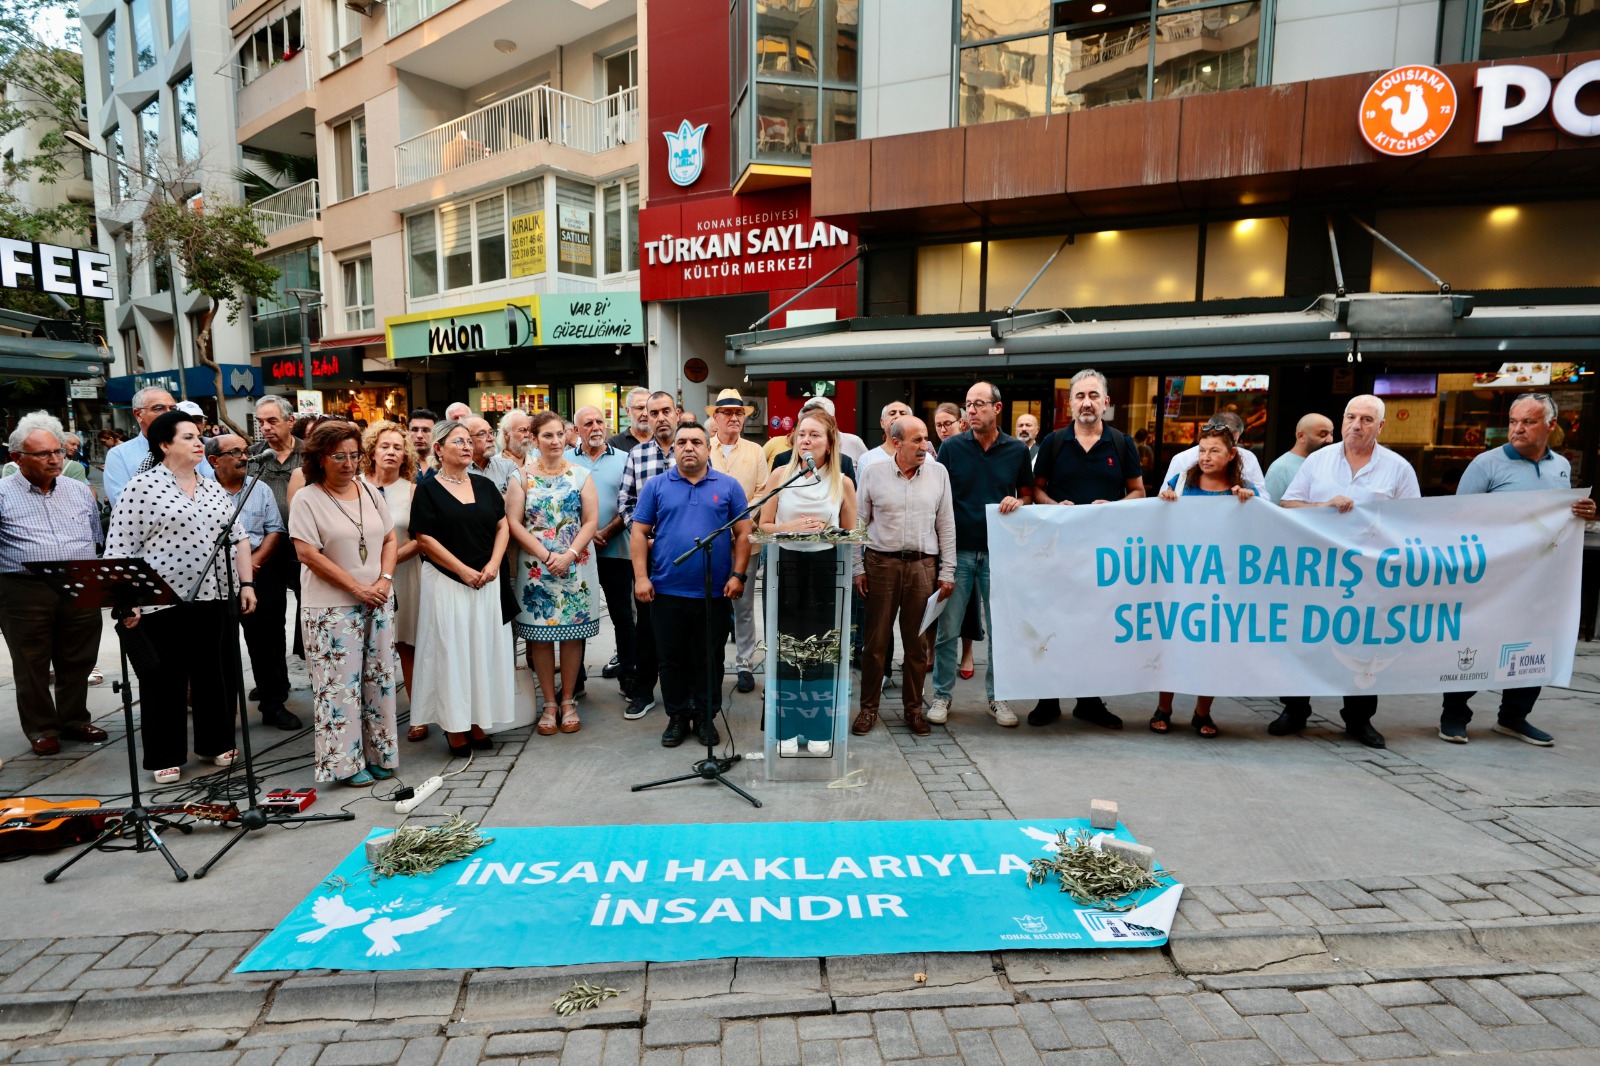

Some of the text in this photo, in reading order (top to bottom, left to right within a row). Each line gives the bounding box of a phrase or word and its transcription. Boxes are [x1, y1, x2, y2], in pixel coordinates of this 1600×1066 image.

[1373, 69, 1446, 97] LOUISIANA
[1365, 110, 1376, 119] 19
[1440, 105, 1451, 114] 72
[1374, 128, 1437, 151] KITCHEN
[697, 208, 799, 231] KONAK BELEDİYESİ
[561, 230, 589, 245] SATILIK
[644, 221, 849, 266] TÜRKAN SAYLAN
[684, 254, 812, 280] KÜLTÜR MERKEZİ
[570, 301, 591, 317] VAR
[1096, 534, 1487, 599] DÜNYA BARIŞ GÜNÜ
[1114, 593, 1463, 645] SEVGİYLE DOLSUN
[1520, 654, 1546, 667] KONAK
[1460, 672, 1489, 680] BELEDİYESİ
[456, 853, 1032, 886] İNSAN HAKLARIYLA
[590, 893, 909, 927] İNSANDIR
[1034, 932, 1083, 941] BELEDİYESİ
